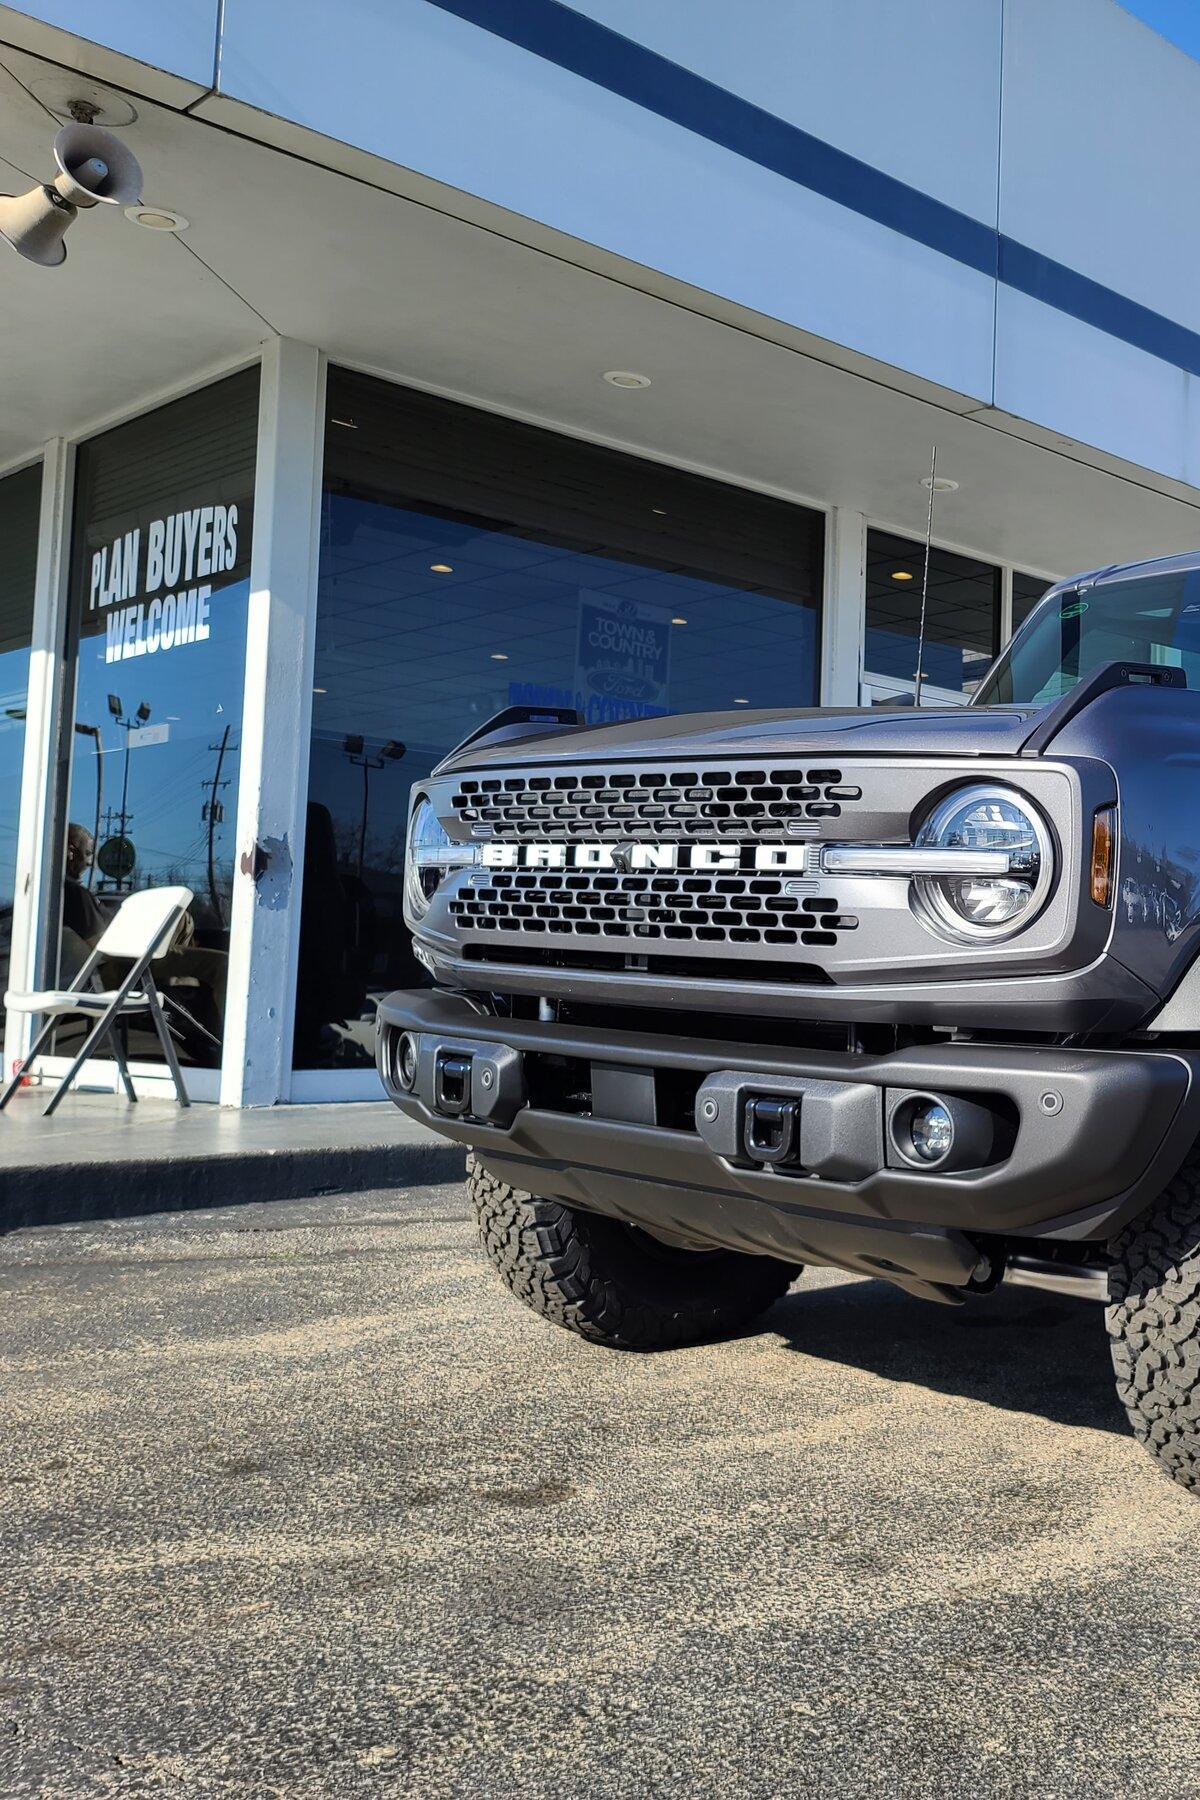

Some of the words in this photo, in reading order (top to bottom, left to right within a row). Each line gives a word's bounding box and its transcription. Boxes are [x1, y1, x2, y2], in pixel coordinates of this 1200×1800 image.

[89, 528, 141, 611] PLAN
[145, 504, 239, 593] BUYERS
[105, 585, 212, 664] WELCOME
[594, 616, 645, 643] TOWN
[645, 628, 657, 646] &
[588, 631, 664, 661] COUNTRY
[602, 671, 647, 698] Ford
[481, 841, 808, 871] BRONCO
